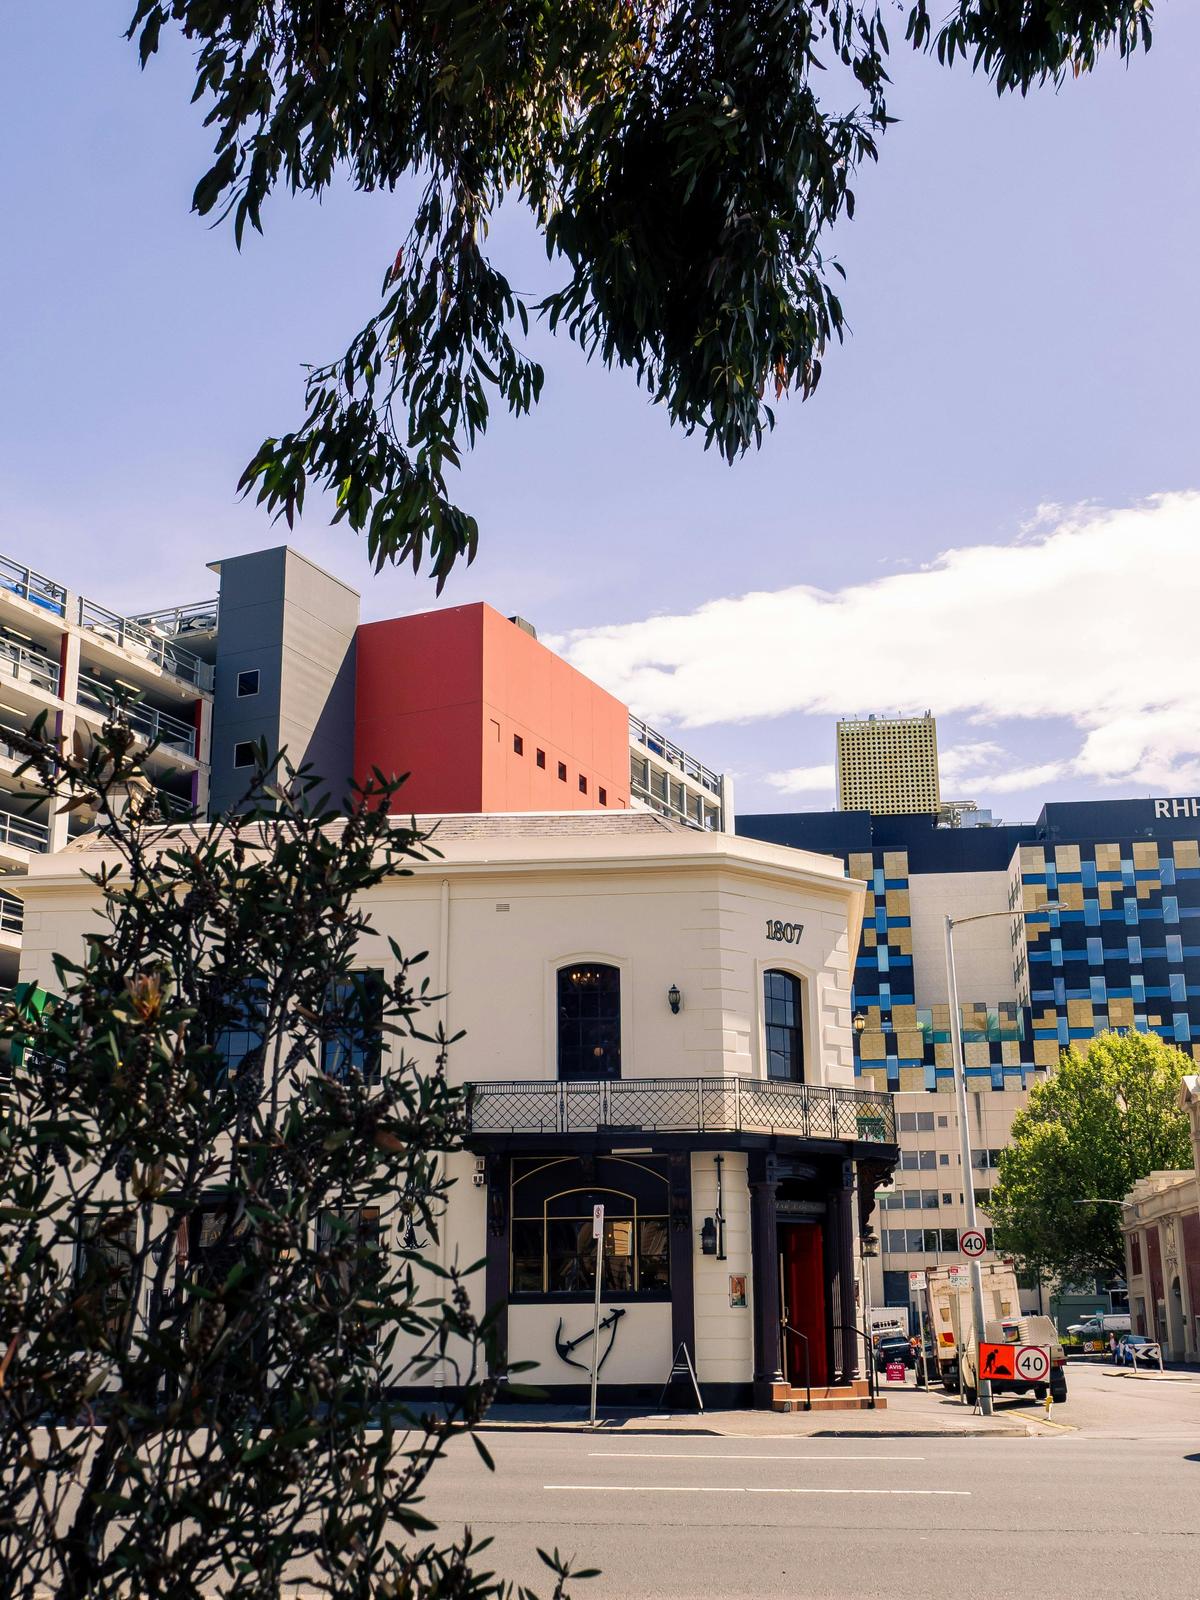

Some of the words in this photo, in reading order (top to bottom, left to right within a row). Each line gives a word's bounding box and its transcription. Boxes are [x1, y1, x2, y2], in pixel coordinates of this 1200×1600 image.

[766, 920, 804, 944] 1807
[964, 1237, 983, 1250] 40
[1021, 1357, 1043, 1371] 40
